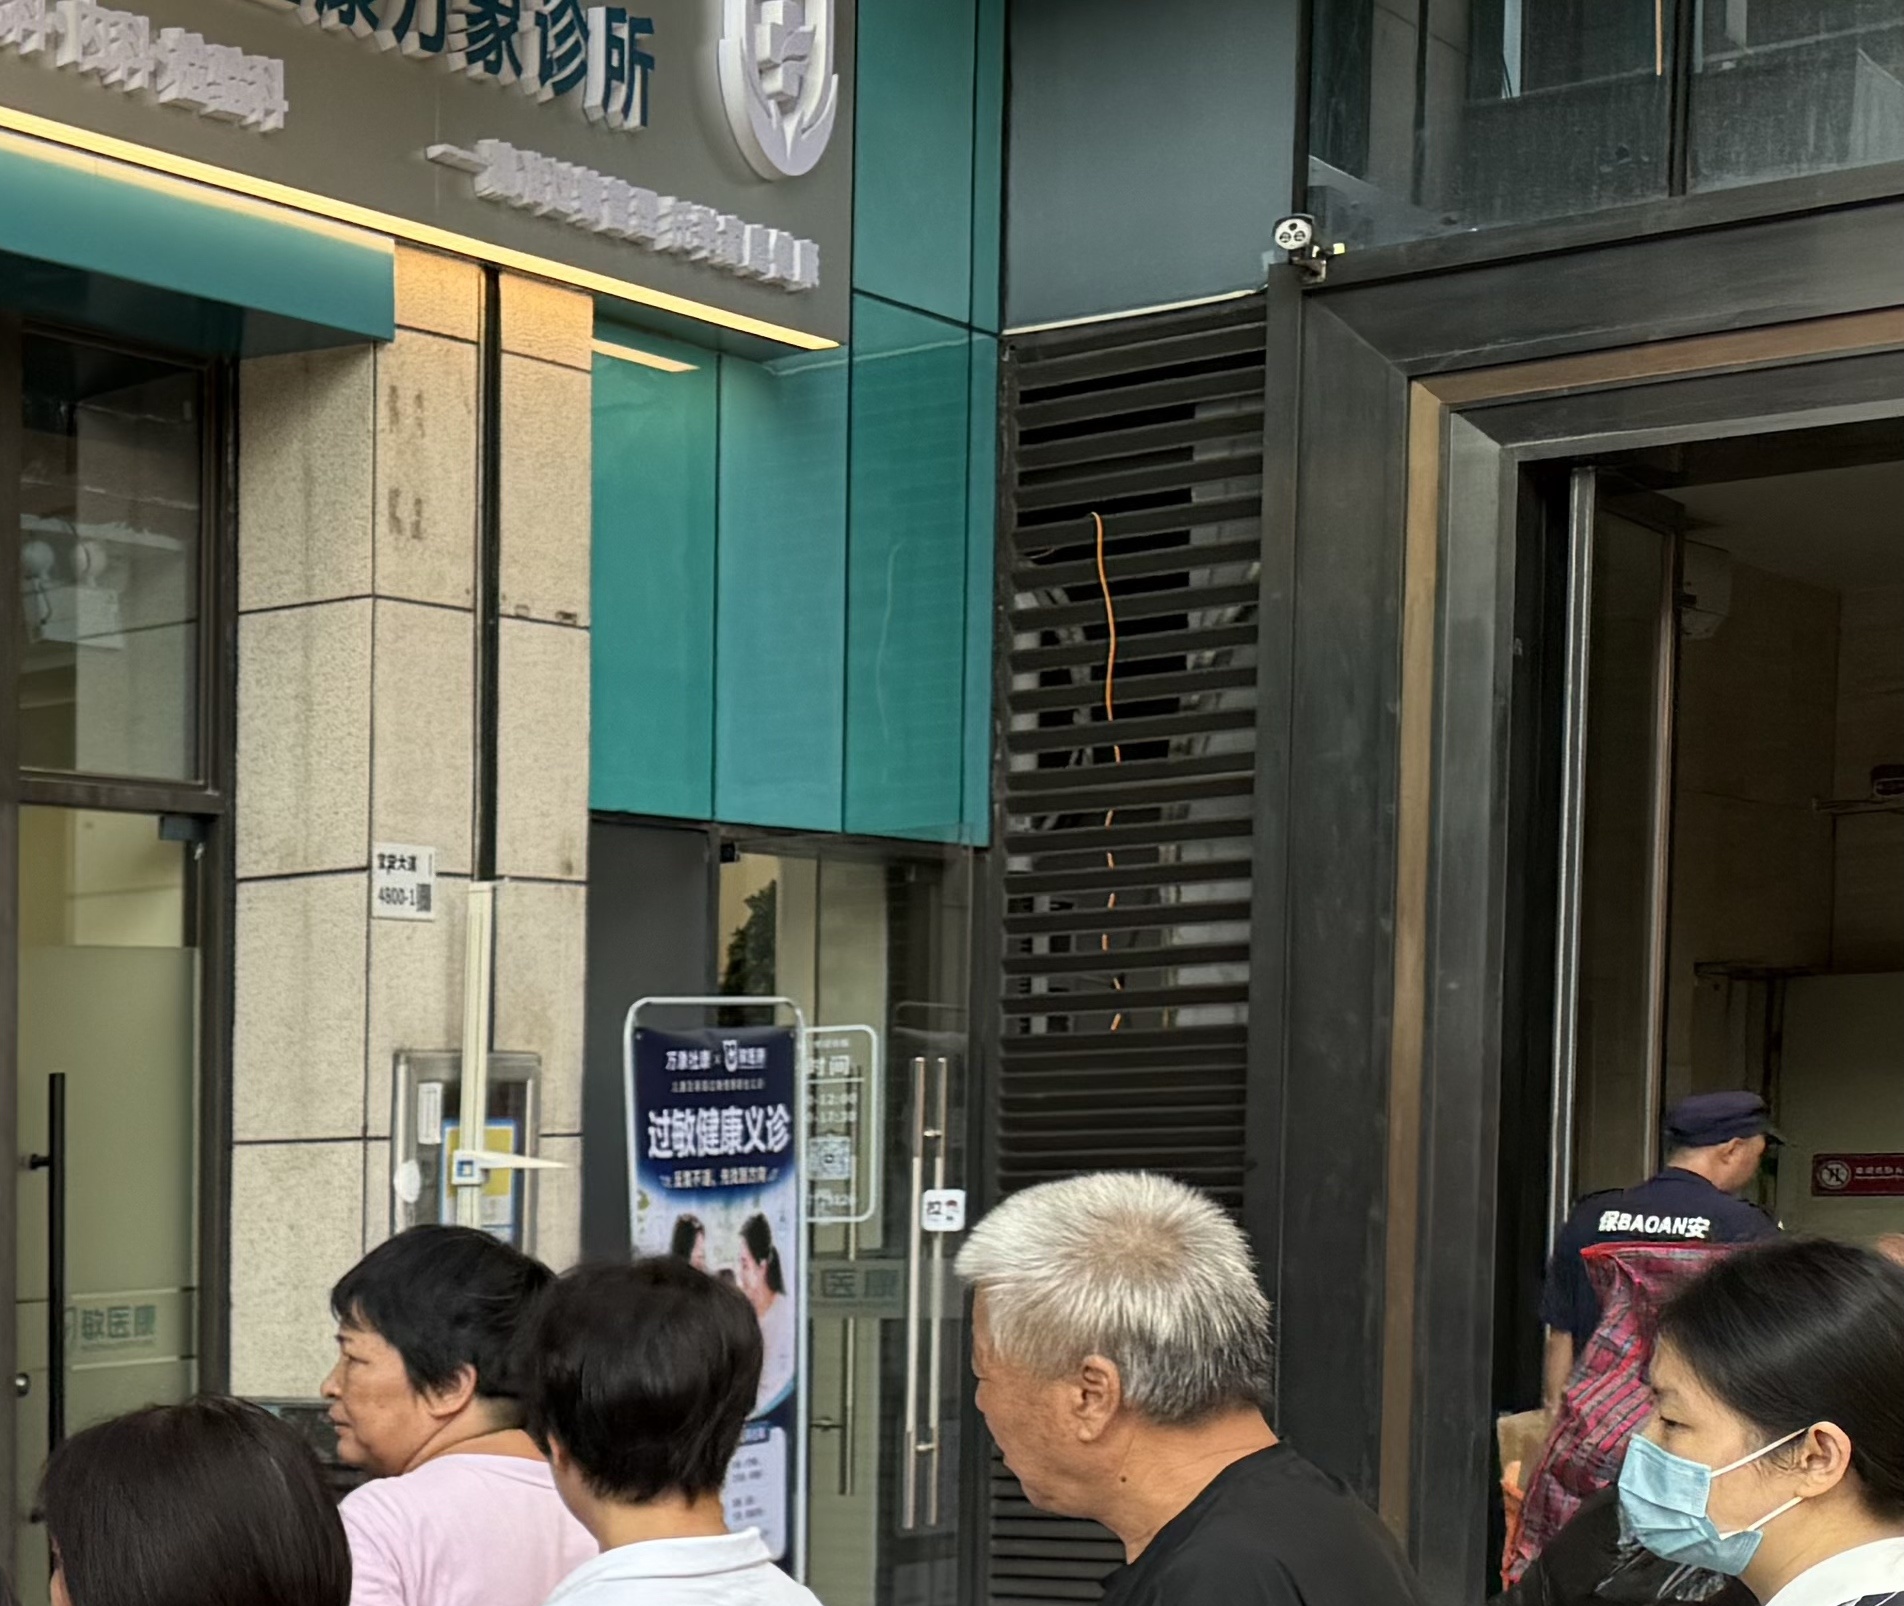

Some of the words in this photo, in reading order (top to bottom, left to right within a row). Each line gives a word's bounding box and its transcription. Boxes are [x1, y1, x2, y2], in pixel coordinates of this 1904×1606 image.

[648, 1103, 792, 1160] 过敏健康义诊
